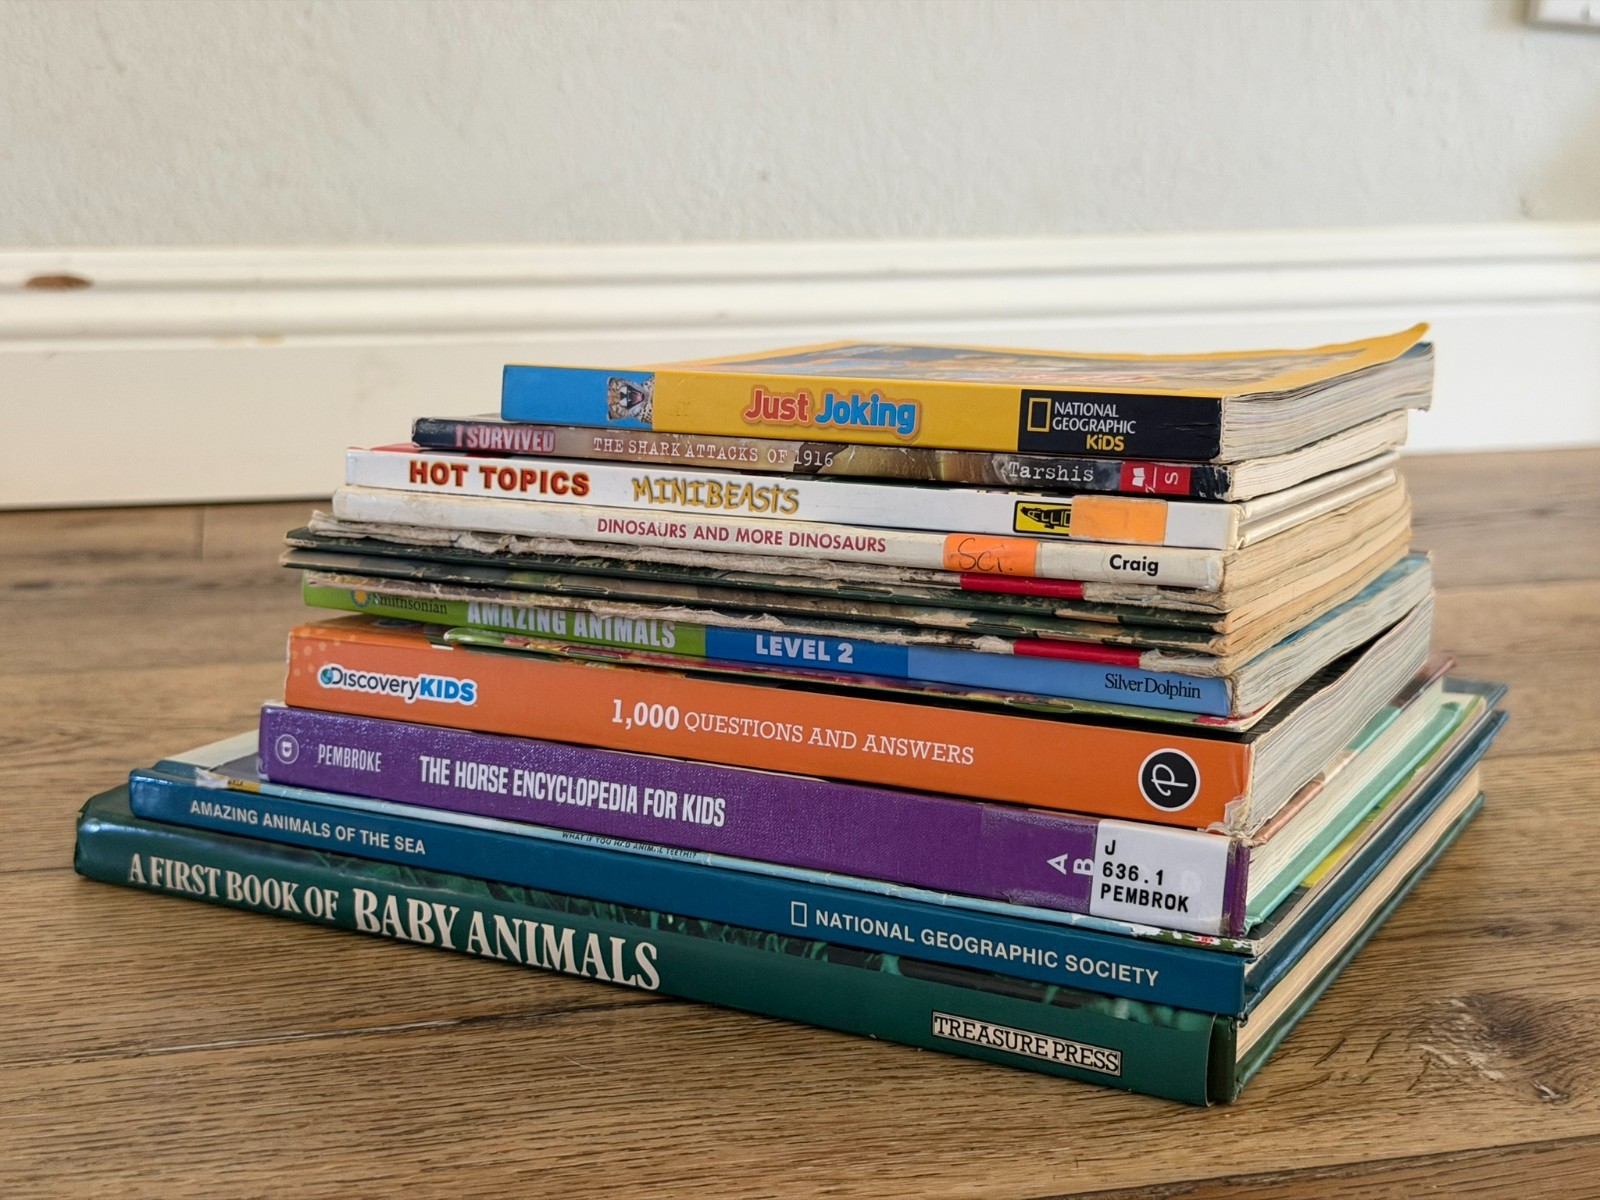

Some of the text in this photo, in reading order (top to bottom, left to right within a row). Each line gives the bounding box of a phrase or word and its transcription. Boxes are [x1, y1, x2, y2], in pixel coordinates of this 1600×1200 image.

[744, 388, 917, 435] Just Joking
[1054, 401, 1119, 418] NATIONAL
[455, 423, 555, 452] I SURVIVED
[1052, 416, 1136, 435] GEOGRAPHIC
[593, 437, 833, 467] THE SHARK ATTACKS OF 1916
[409, 460, 591, 497] HOT TOPICS
[1008, 461, 1094, 483] Tarshis
[597, 518, 886, 553] DINOSAURS AND MORE DINOSAURS
[1109, 554, 1159, 577] Craig
[467, 600, 676, 649] AMAZING ANIMALS
[756, 634, 853, 664] LEVEL 2
[1104, 672, 1201, 700] Silver Dolphin
[611, 698, 974, 766] 1,000 QUESTIONS AND ANSWERS
[318, 743, 382, 773] PEMBROKE
[419, 754, 726, 828] THE HORSE ENCYCLOPEDIA FOR KIDS
[190, 799, 426, 856] AMAZING ANIMALS OF THE SEA
[562, 831, 584, 841] WHAT
[595, 836, 612, 846] YOU
[1104, 839, 1116, 856] J
[1102, 861, 1164, 886] 636.1
[1100, 882, 1190, 913] PEMBROK
[129, 853, 661, 992] A FIRST BOOK OF BABY ANIMALS
[815, 910, 1159, 987] NATIONAL GEOGRAPHIC SOCIETY
[934, 1015, 1119, 1072] TREASURE PRESS
